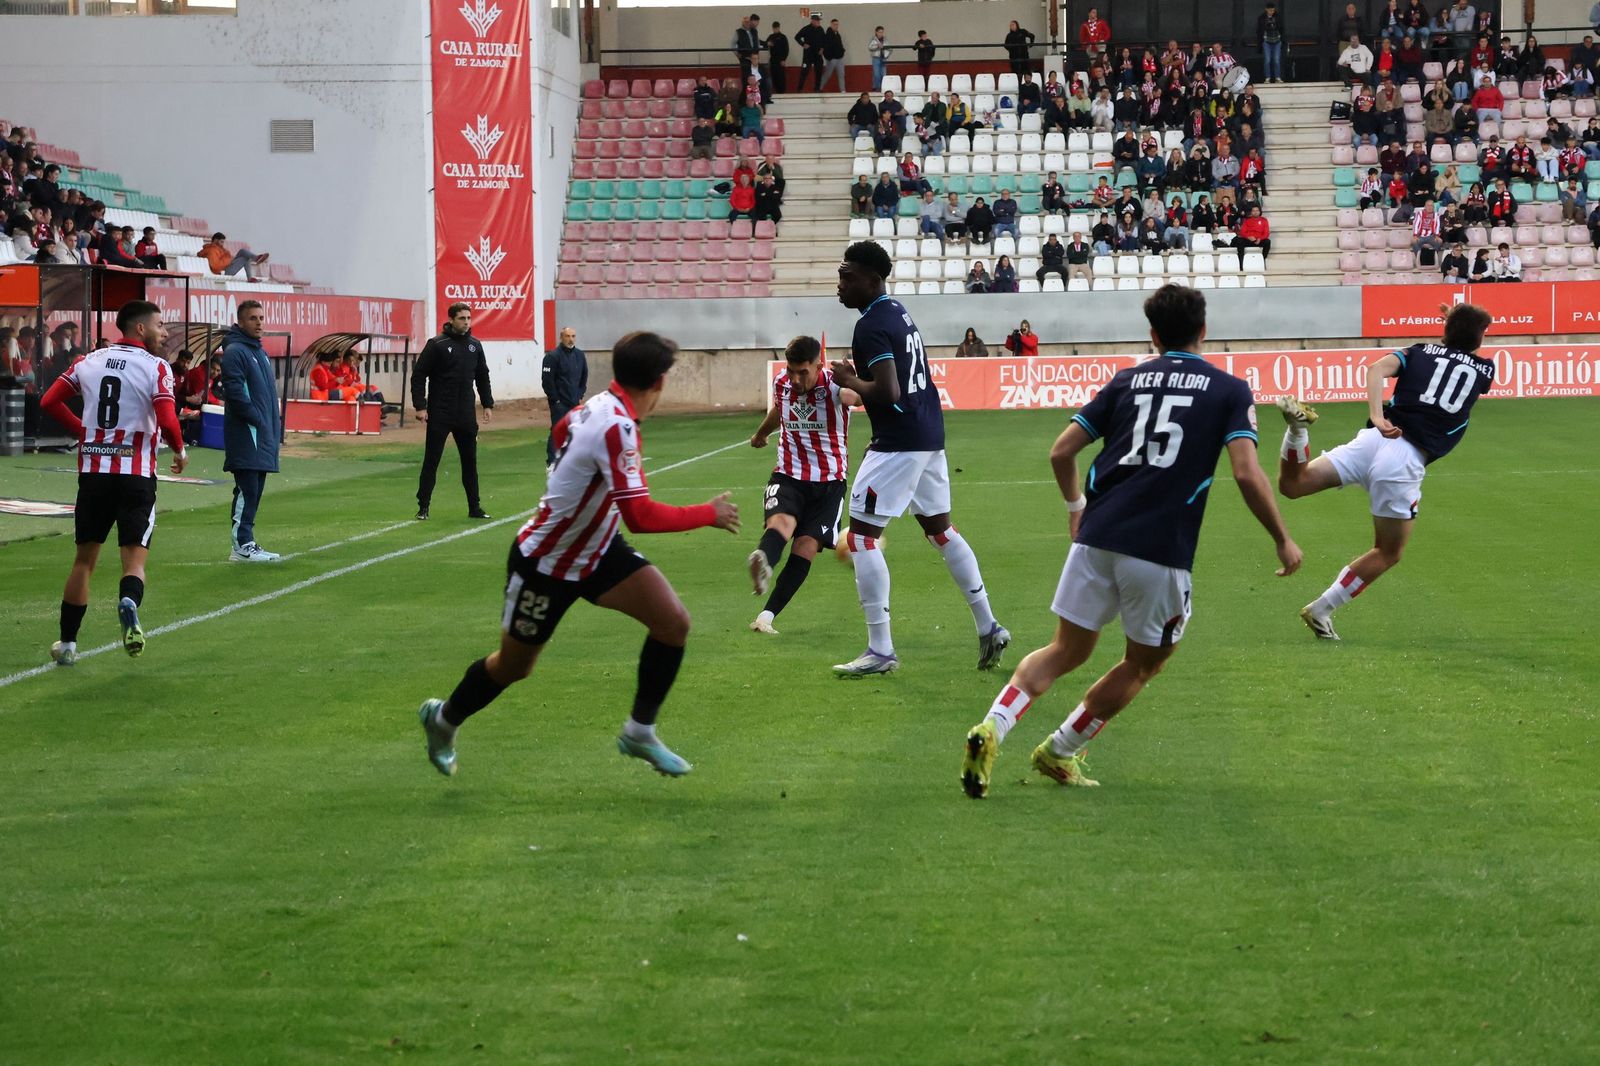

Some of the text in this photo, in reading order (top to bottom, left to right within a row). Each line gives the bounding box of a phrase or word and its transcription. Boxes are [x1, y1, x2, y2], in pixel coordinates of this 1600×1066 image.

[440, 41, 521, 57] CAJA RURAL
[455, 58, 507, 68] DE ZAMORA
[443, 163, 524, 178] CAJA RURAL
[457, 180, 510, 189] DE ZAMORA
[445, 285, 526, 298] CAJA RURAL
[474, 301, 512, 310] ZAMORA
[296, 301, 305, 325] DE
[307, 302, 328, 326] STAND
[1381, 317, 1396, 325] LA
[1492, 316, 1506, 324] LA
[1510, 315, 1534, 323] LUZ
[105, 358, 127, 370] RUFO
[905, 331, 927, 394] 23
[1000, 359, 1117, 384] FUNDACIÓN
[1130, 372, 1210, 391] IKER ALDAI
[1419, 357, 1478, 414] 10
[1306, 390, 1321, 400] de
[1526, 385, 1541, 396] de
[1543, 385, 1593, 396] Zamora
[97, 375, 121, 429] 8
[1118, 393, 1194, 468] 15
[519, 590, 550, 620] 22
